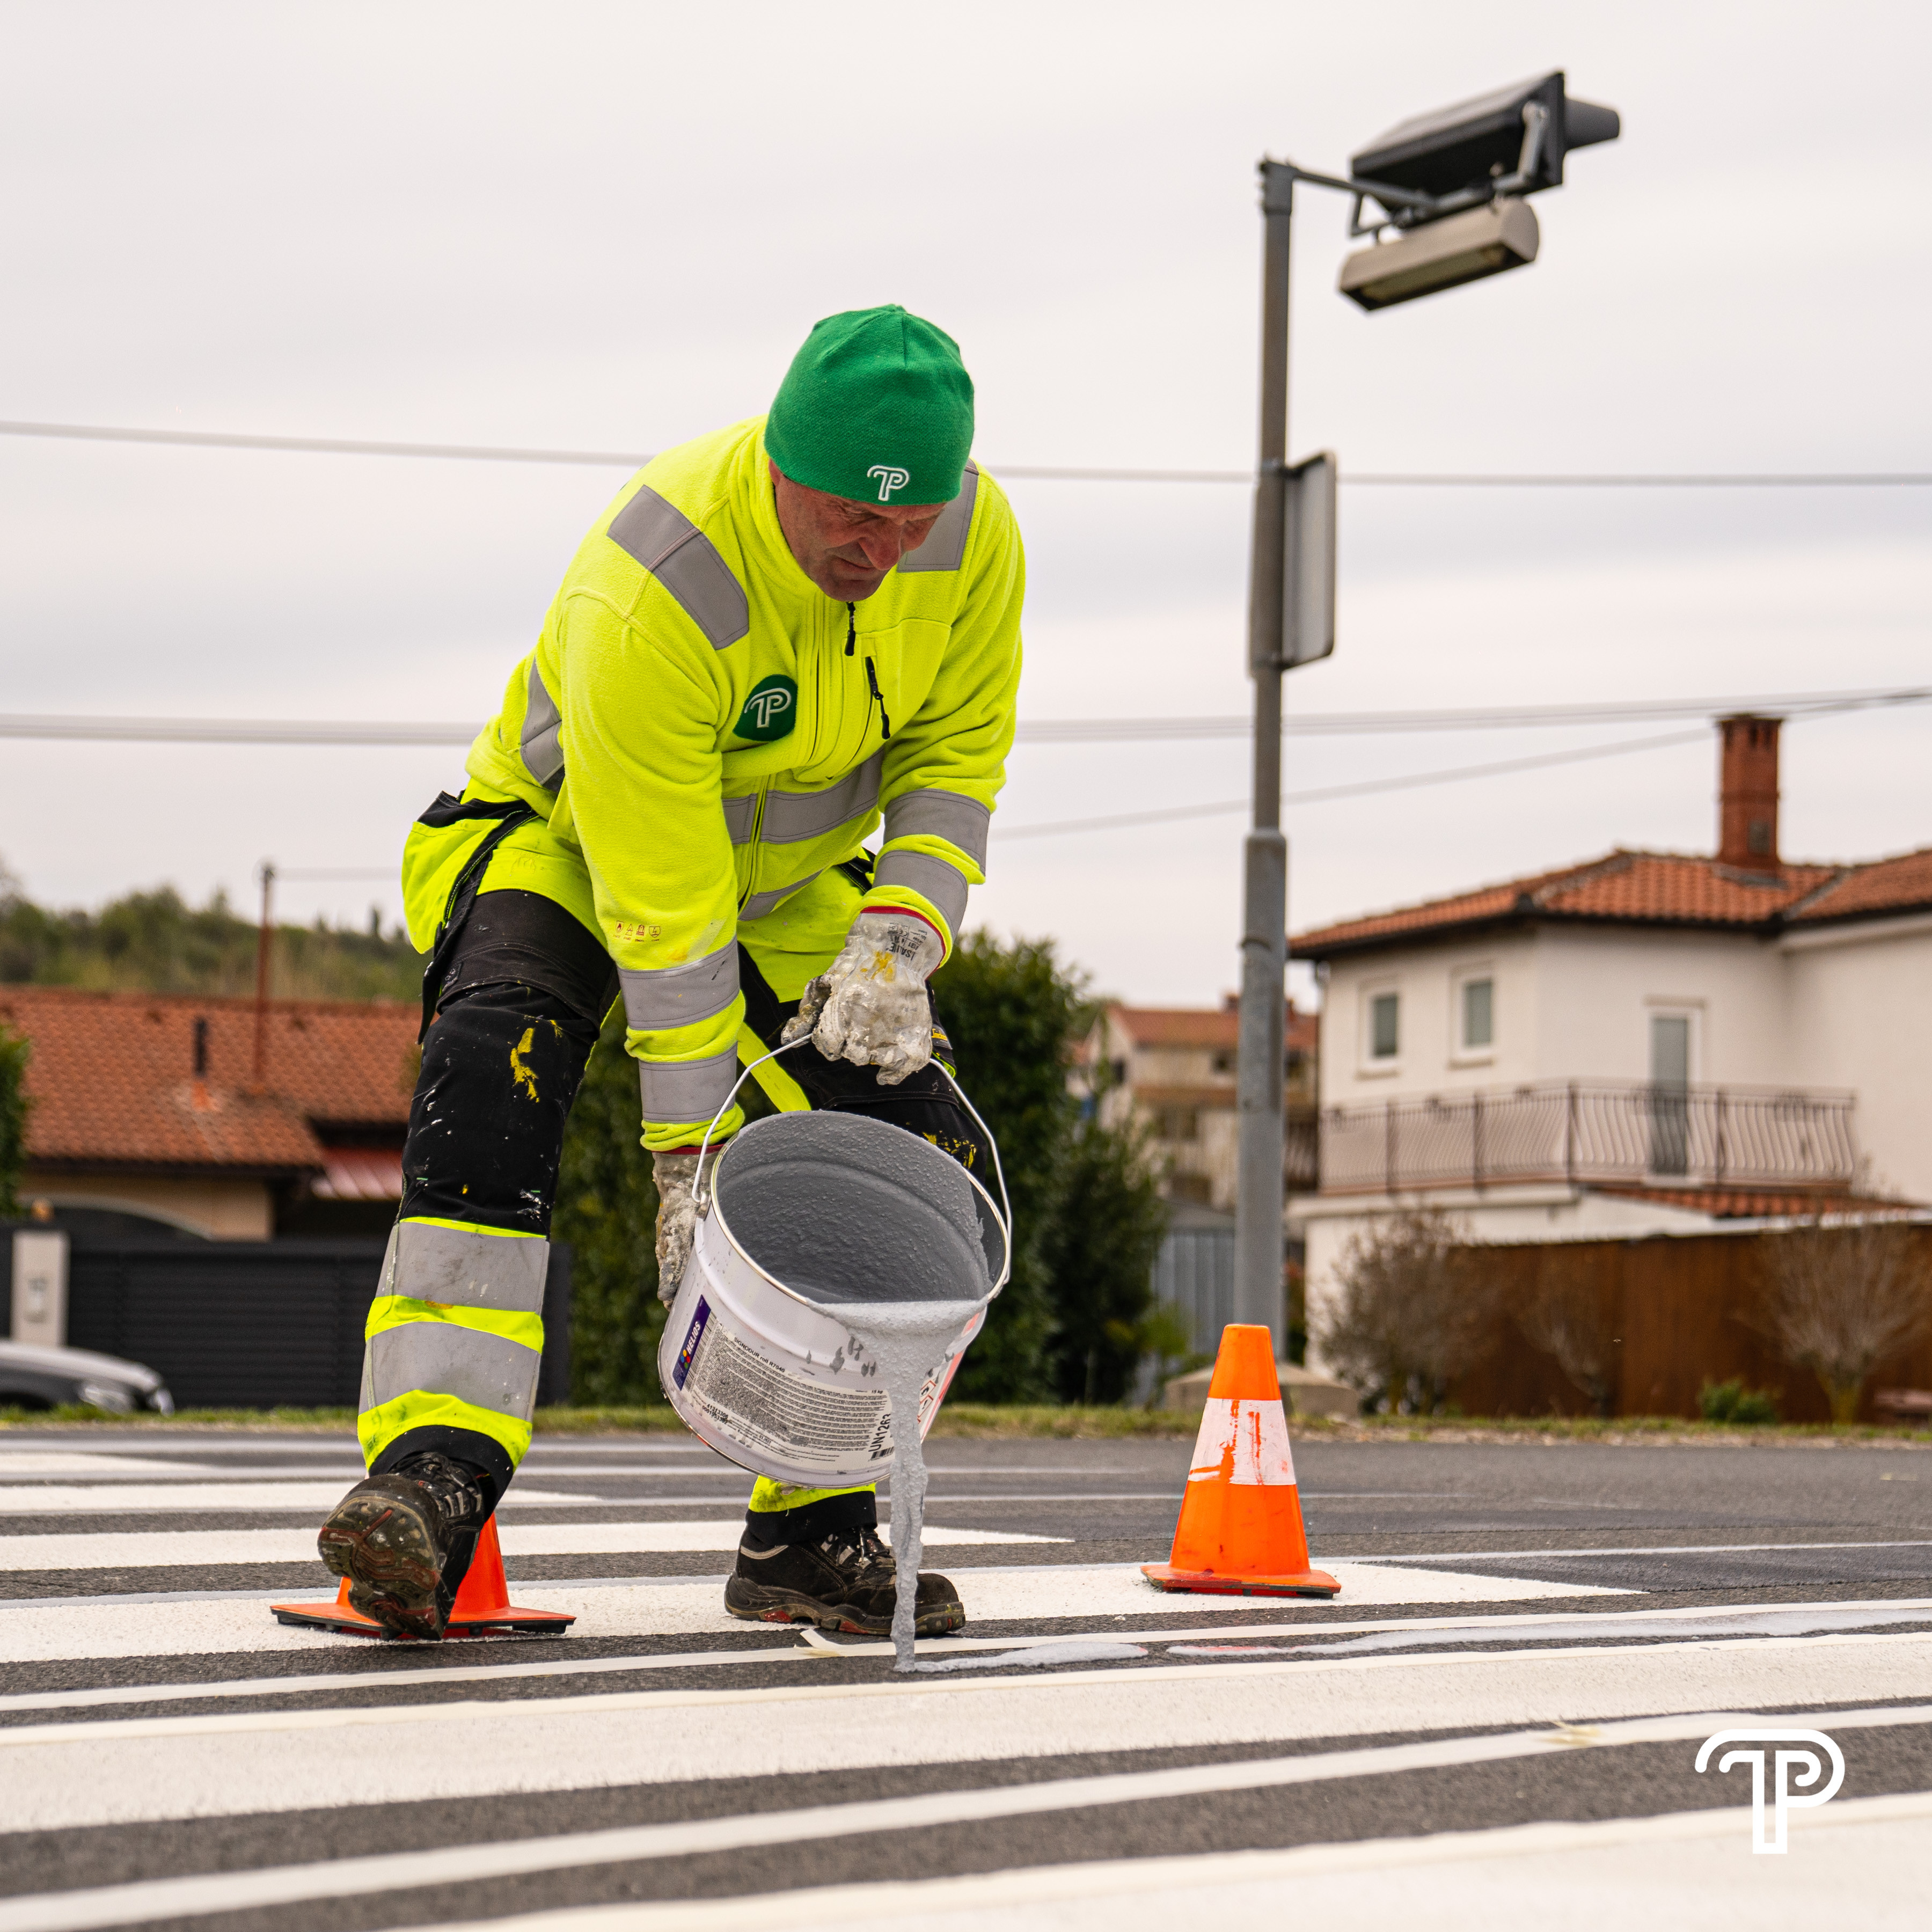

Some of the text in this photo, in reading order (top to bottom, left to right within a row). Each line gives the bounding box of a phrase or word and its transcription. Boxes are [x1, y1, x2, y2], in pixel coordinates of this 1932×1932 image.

[686, 1321, 700, 1355] HELIOS
[733, 1337, 760, 1358] SIGNODUR
[769, 1361, 785, 1373] R7040
